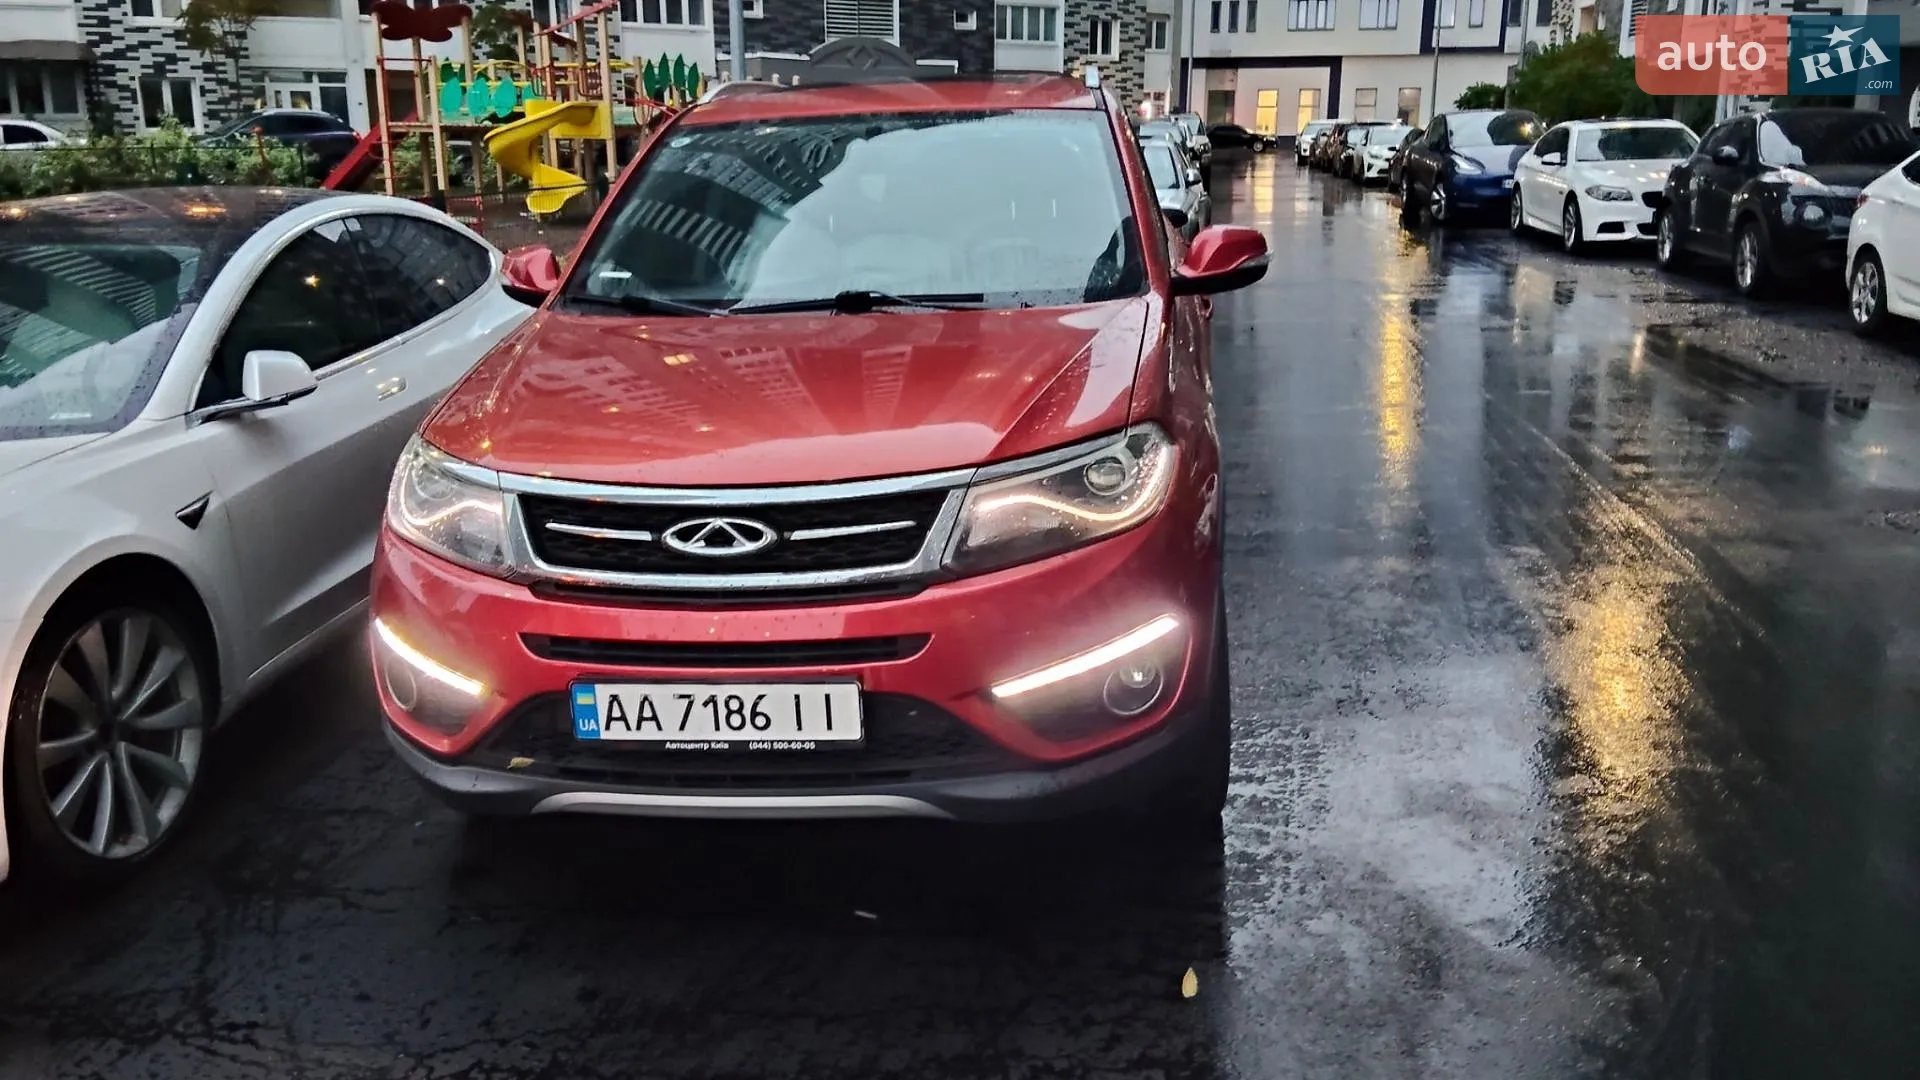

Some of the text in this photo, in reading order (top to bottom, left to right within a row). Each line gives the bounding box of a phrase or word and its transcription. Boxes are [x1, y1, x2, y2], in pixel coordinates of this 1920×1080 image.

[604, 693, 663, 732] AA
[673, 693, 772, 732] 7186
[579, 718, 598, 732] UA
[665, 741, 709, 750] Автоцентр
[749, 741, 771, 750] (044)
